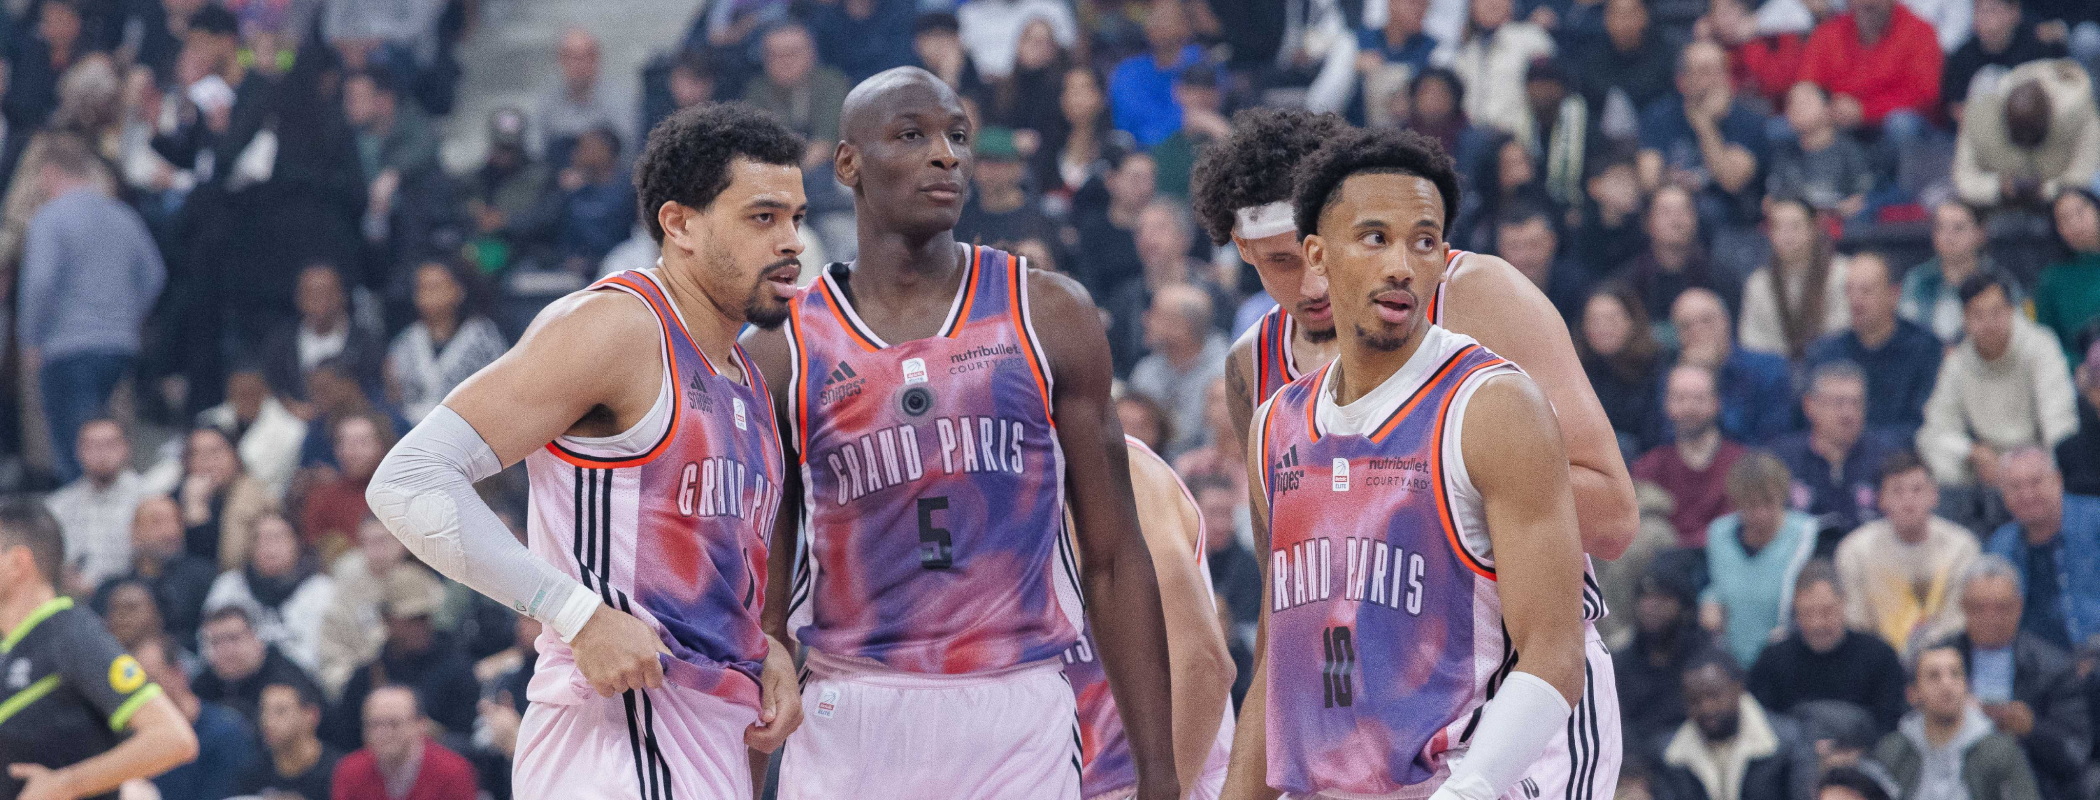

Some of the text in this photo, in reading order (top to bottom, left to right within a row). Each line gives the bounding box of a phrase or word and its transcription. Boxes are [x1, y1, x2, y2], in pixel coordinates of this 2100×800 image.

[820, 380, 862, 406] snipes
[949, 357, 1022, 375] COURTYARD
[676, 456, 745, 521] GRAND
[827, 423, 924, 507] GRAND
[935, 415, 1026, 475] PARIS
[1274, 470, 1300, 495] nipes
[1365, 476, 1428, 490] COURTYARD
[917, 496, 953, 569] 5
[1272, 537, 1425, 617] RAND PARIS
[1323, 626, 1355, 708] 10
